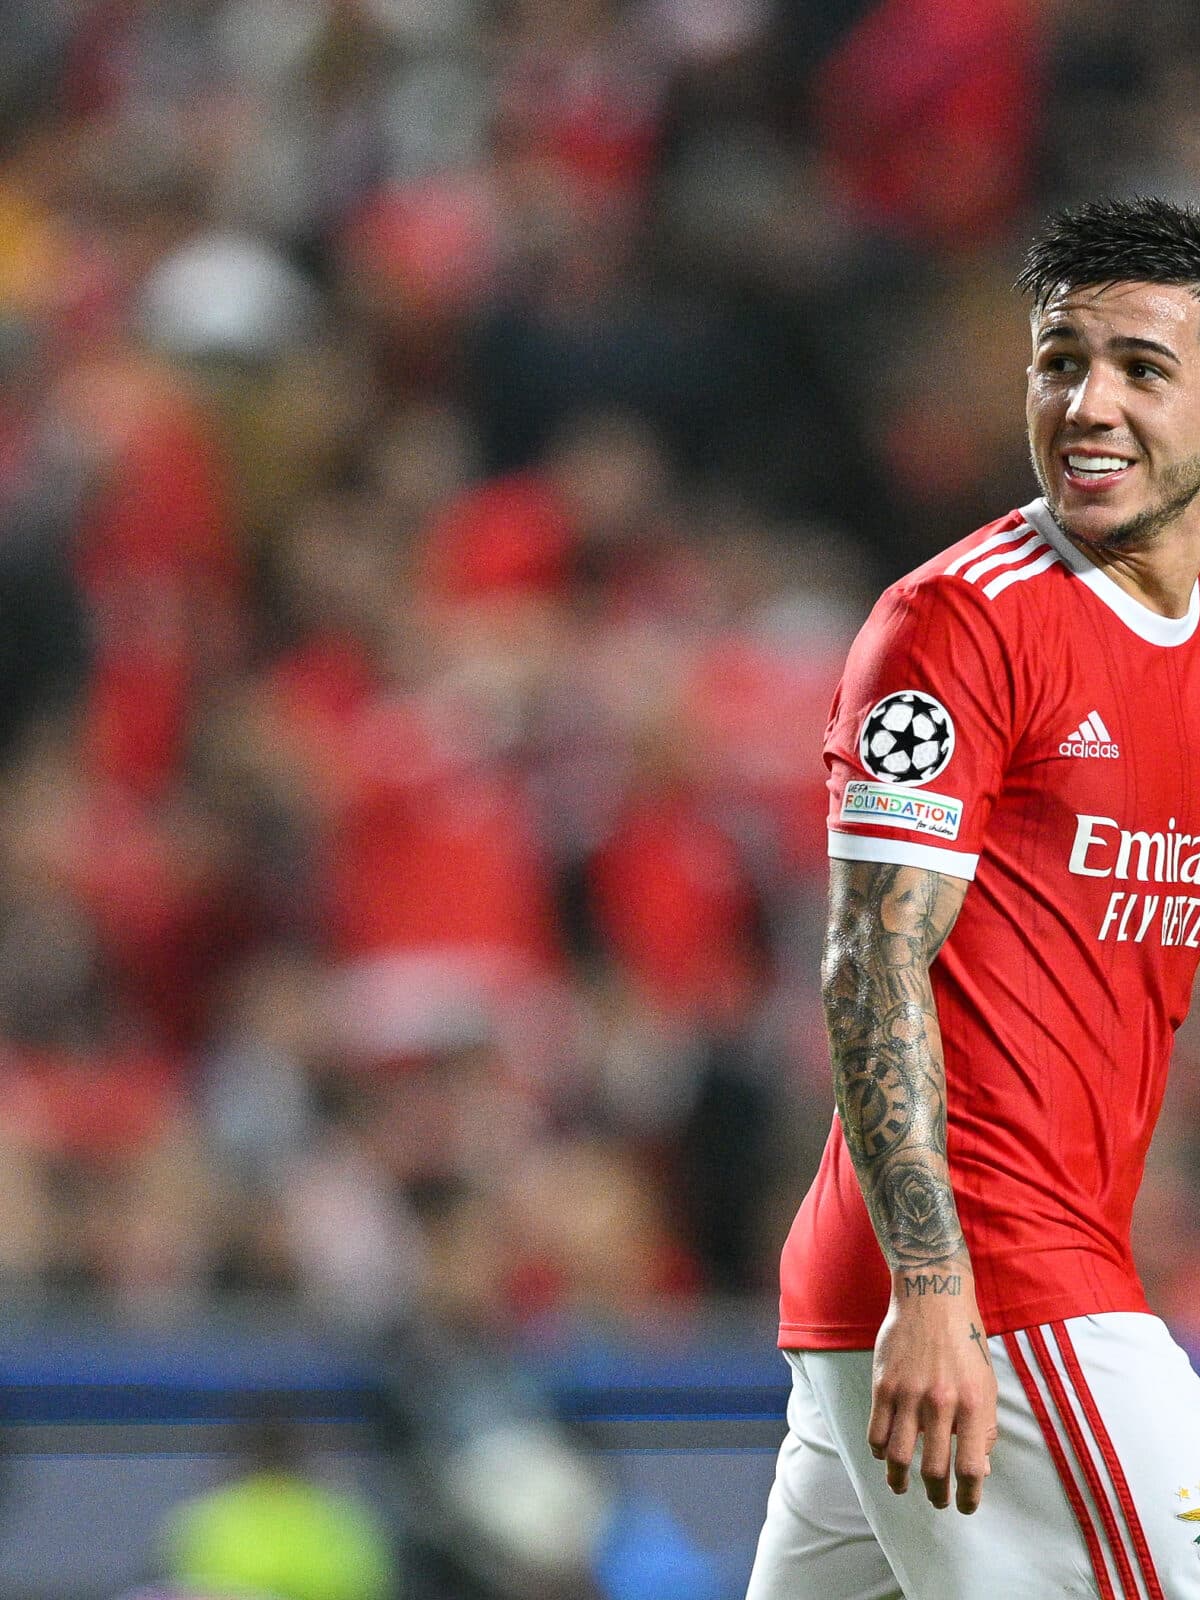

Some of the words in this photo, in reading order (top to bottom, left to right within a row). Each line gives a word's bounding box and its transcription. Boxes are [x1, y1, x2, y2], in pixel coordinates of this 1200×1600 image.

[1058, 739, 1120, 759] adidas
[848, 783, 869, 794] UEFA
[845, 795, 958, 826] FOUNDATION
[1097, 891, 1160, 943] FLY
